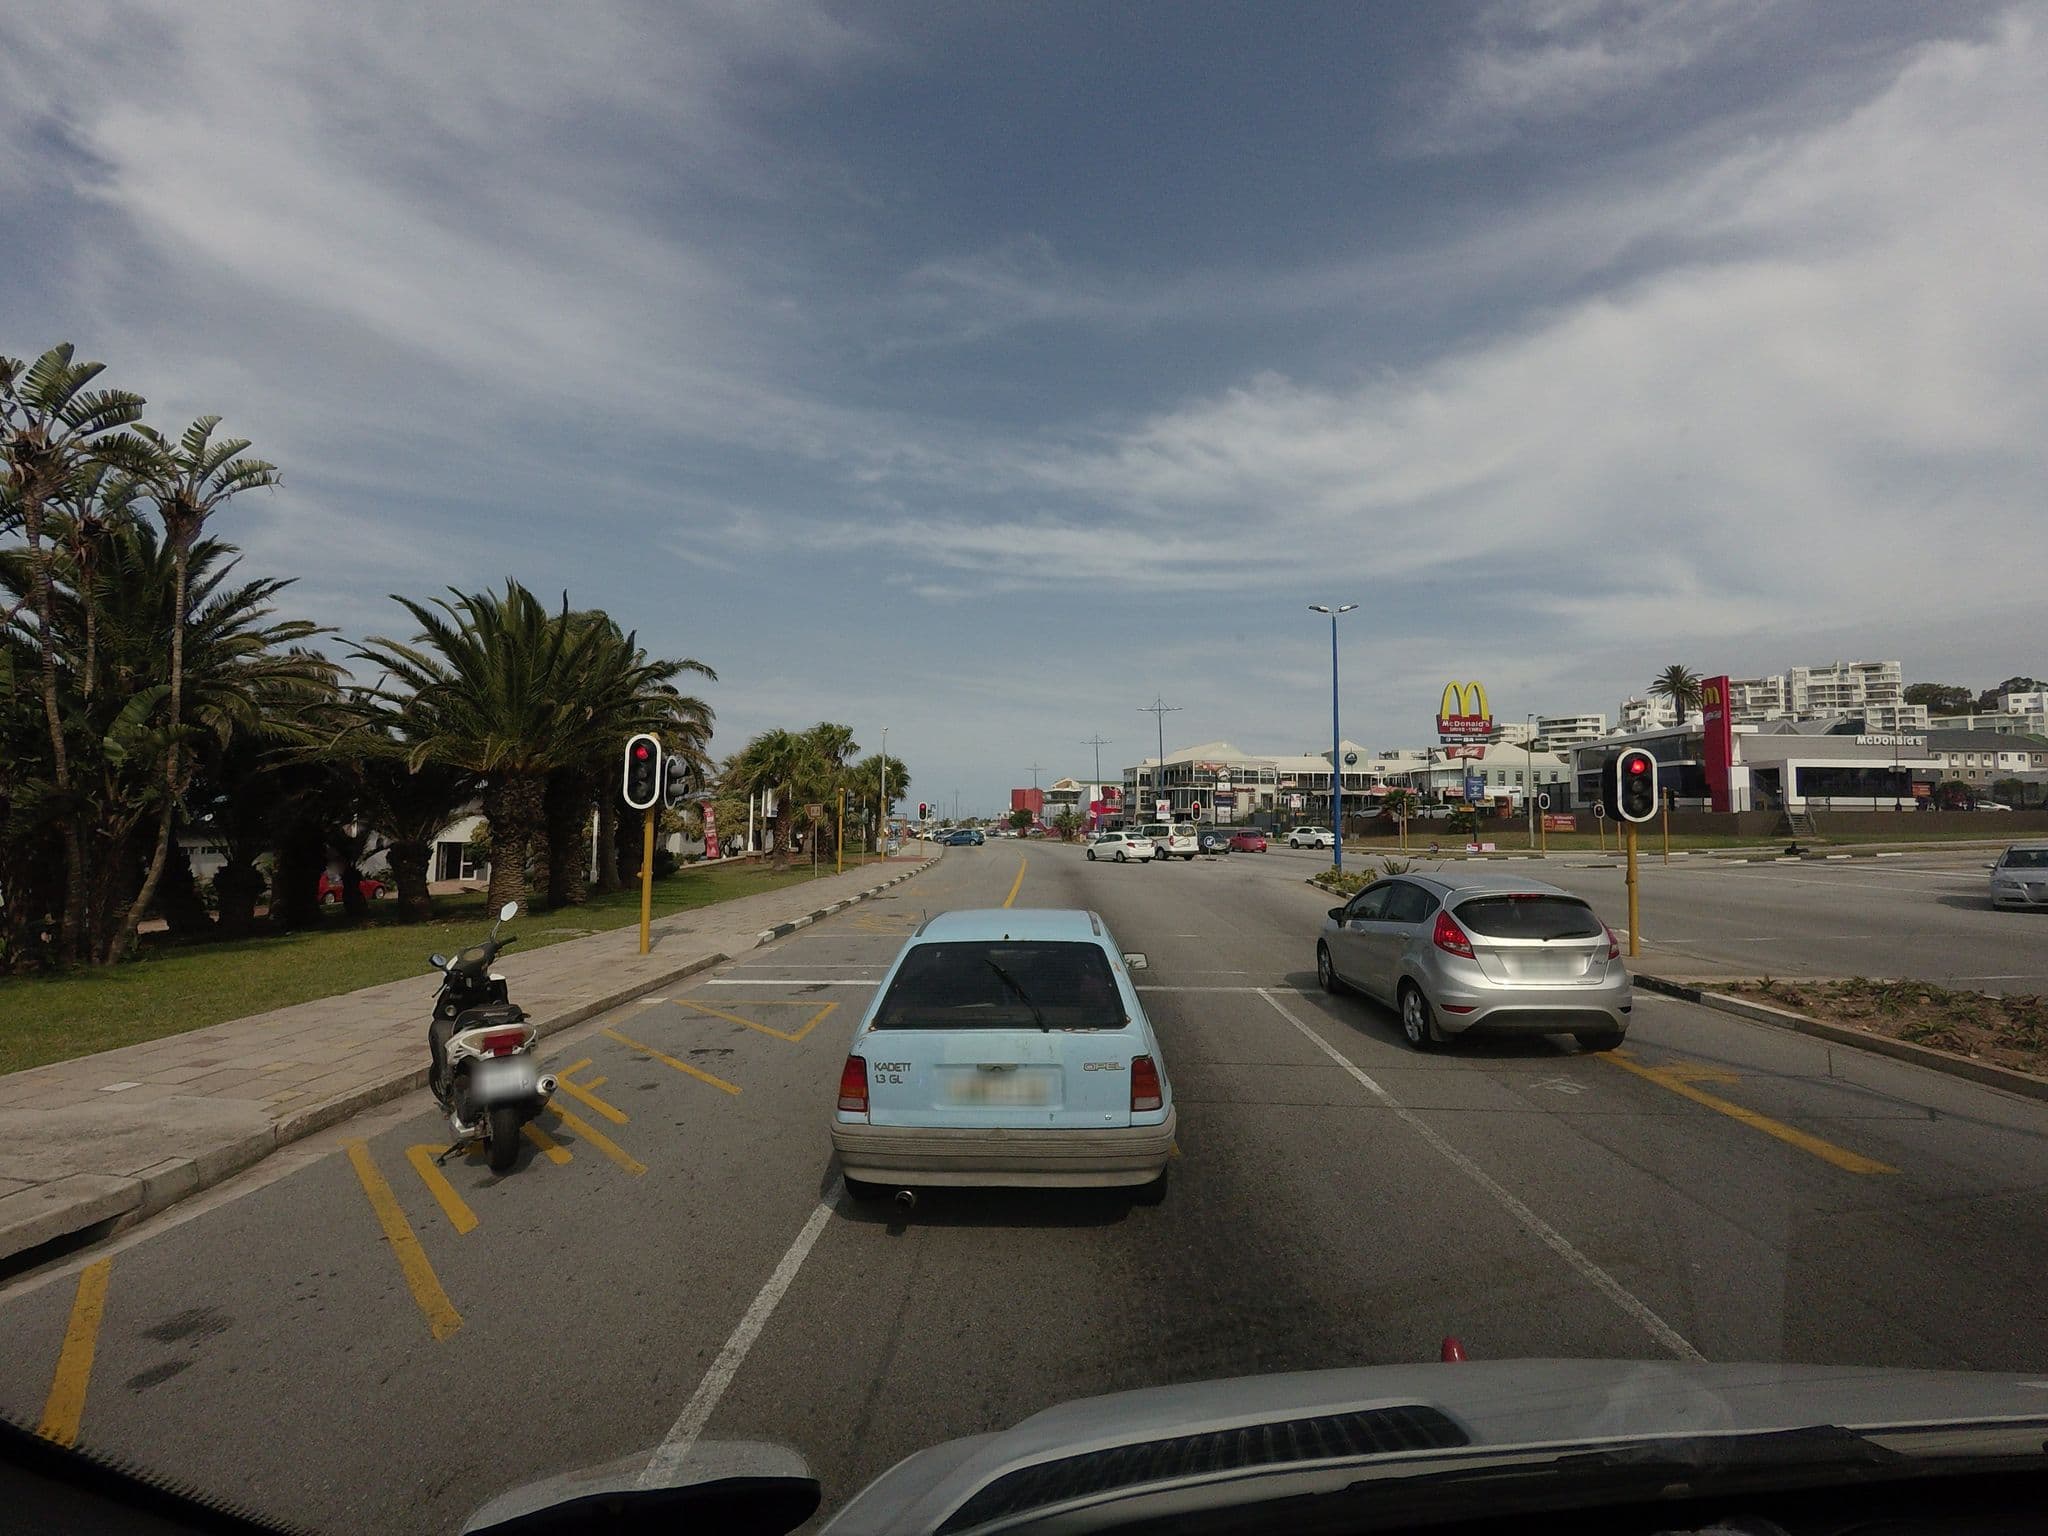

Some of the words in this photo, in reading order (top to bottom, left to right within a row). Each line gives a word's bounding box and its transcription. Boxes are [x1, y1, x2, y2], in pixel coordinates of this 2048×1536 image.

[1856, 735, 1922, 745] McDonald's
[874, 1062, 912, 1072] KADETT
[1083, 1062, 1126, 1071] OPEL
[889, 1074, 904, 1084] GL
